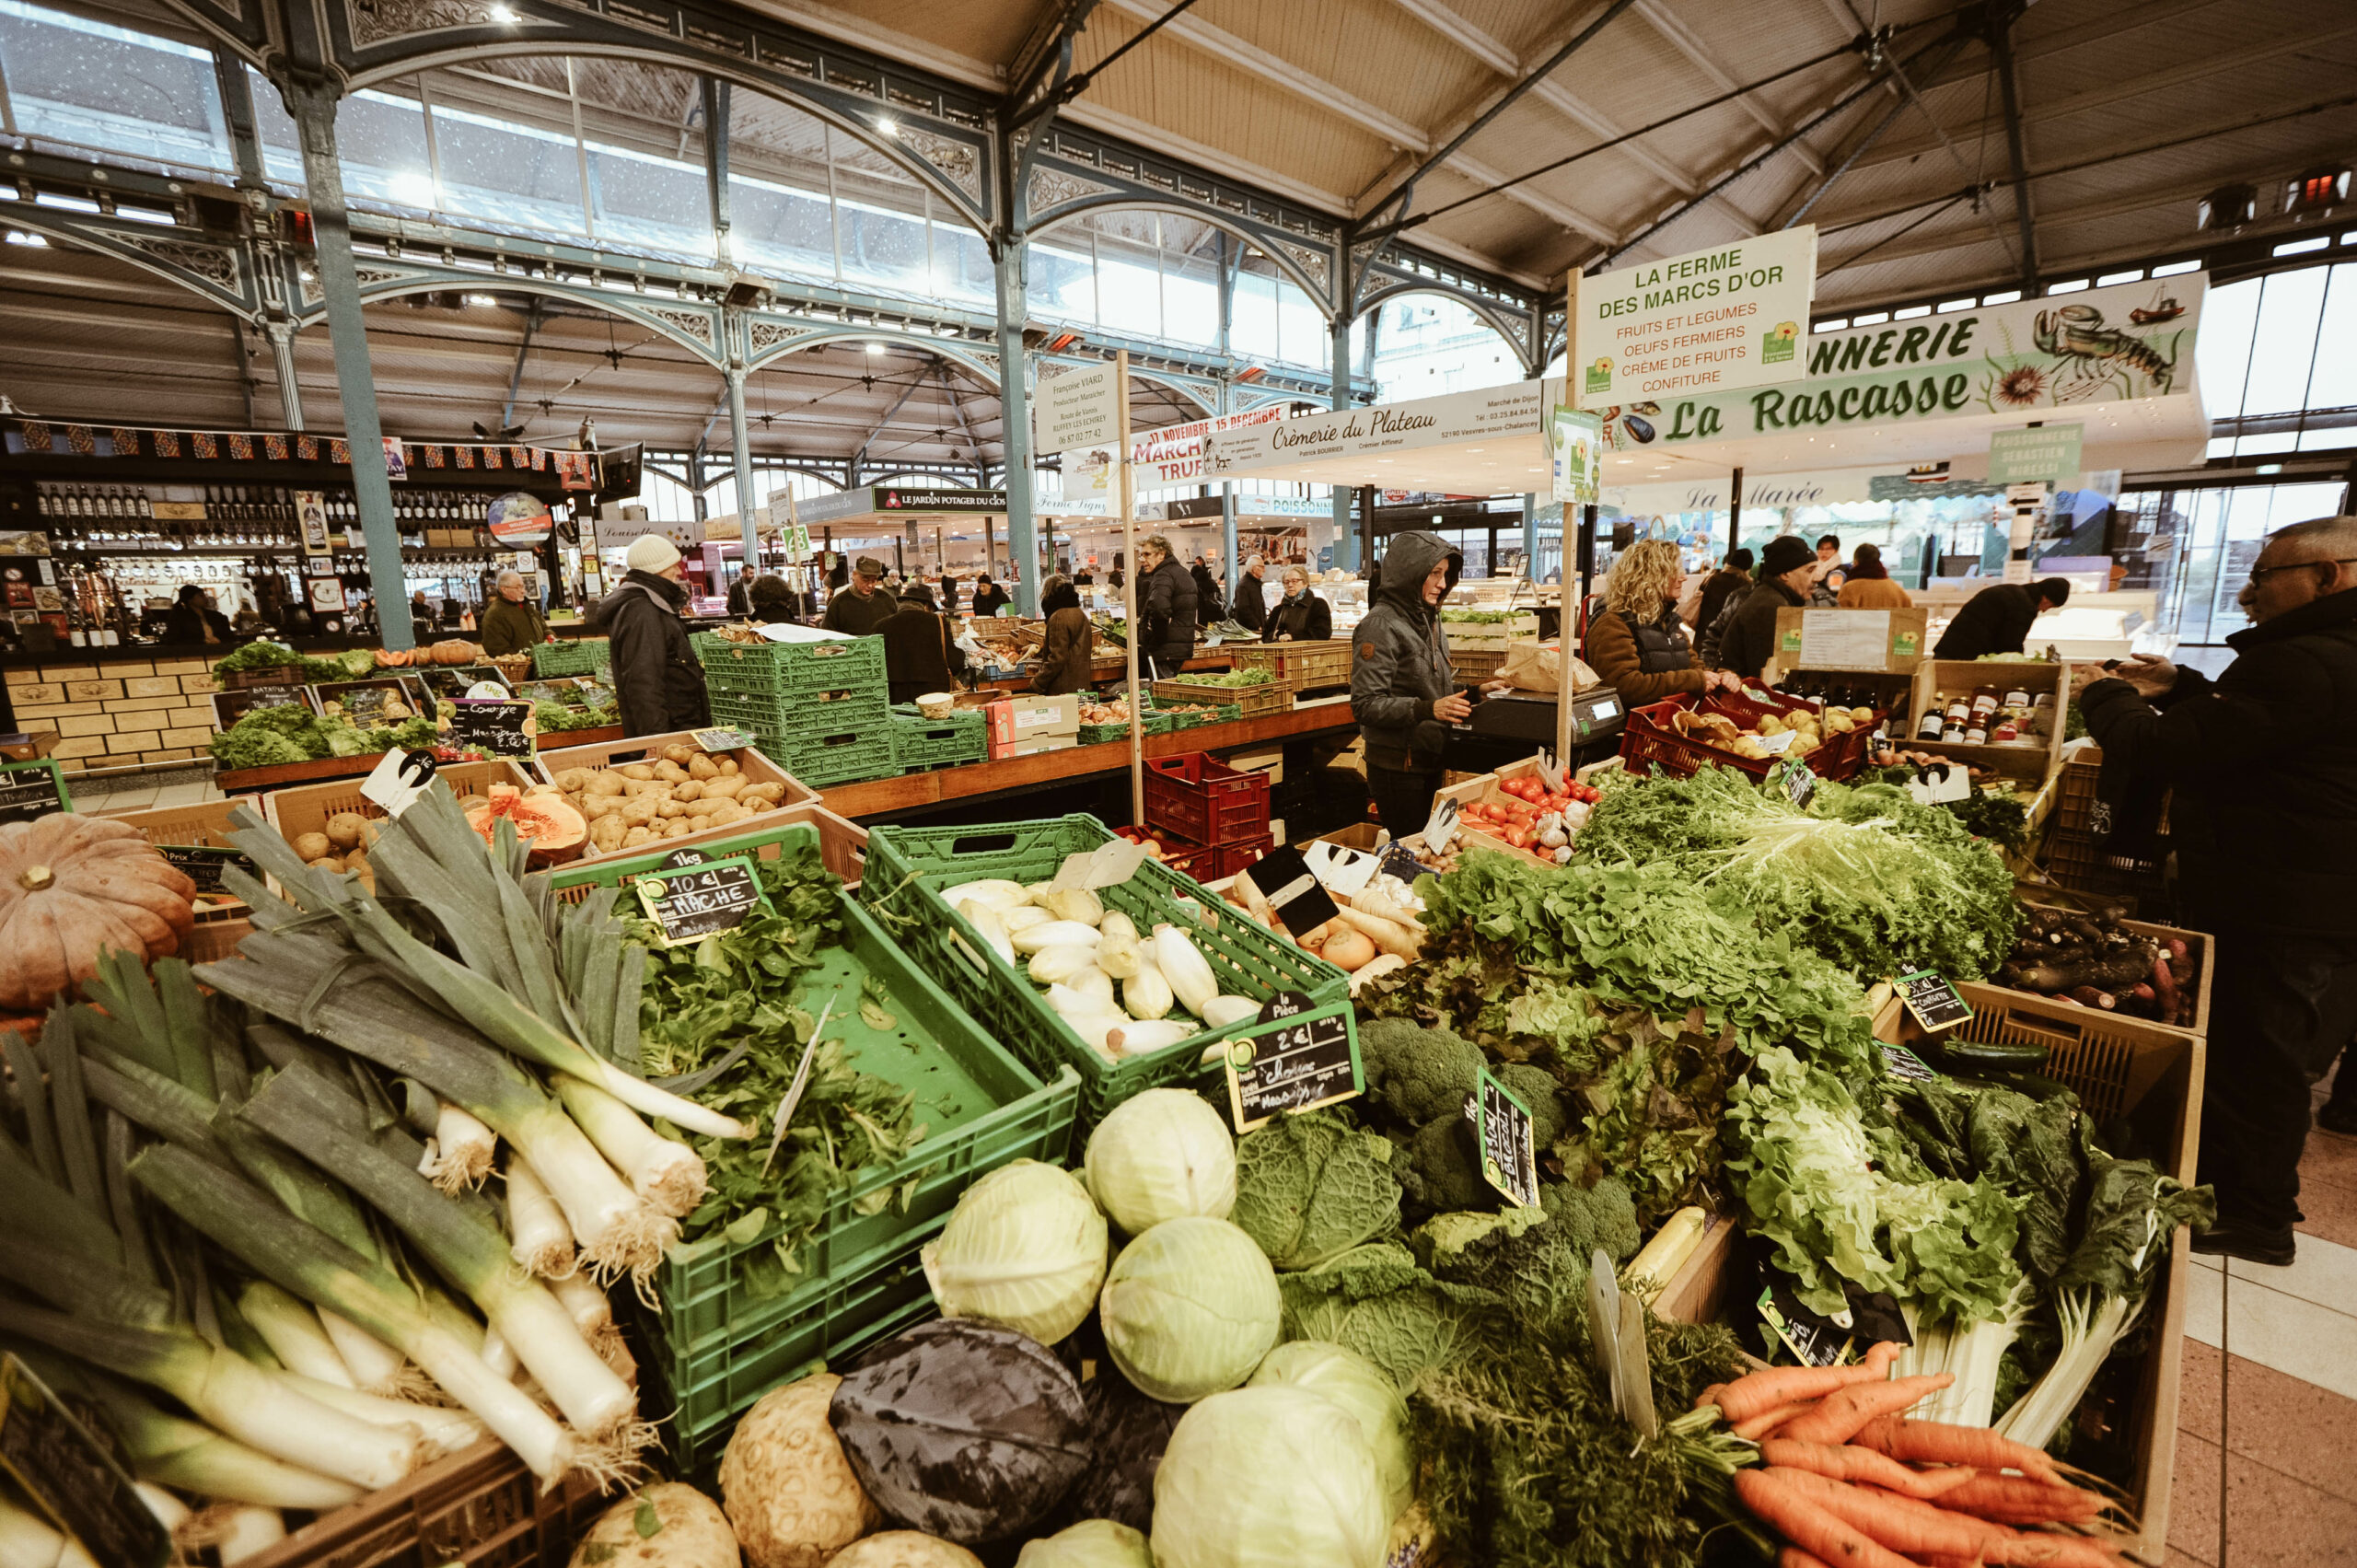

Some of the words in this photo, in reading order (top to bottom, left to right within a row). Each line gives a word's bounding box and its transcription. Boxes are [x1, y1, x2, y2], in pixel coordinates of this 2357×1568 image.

[1635, 268, 1660, 288] LA
[1667, 249, 1742, 281] FERME
[1599, 297, 1638, 319] DES
[1644, 279, 1720, 309] MARCS
[1728, 266, 1783, 293] D'OR
[1617, 320, 1662, 340] FRUITS
[1666, 317, 1683, 331] ET
[1688, 303, 1758, 327] LEGUMES
[1624, 341, 1669, 357] OEUFS
[1673, 326, 1746, 349] FERMIERS
[1806, 318, 1980, 375] NNERIE
[1622, 359, 1668, 377] CRÈME
[1672, 355, 1690, 368] DE
[1695, 346, 1746, 366] FRUITS
[1053, 381, 1080, 396] Françoise
[1081, 374, 1104, 388] VIARD
[1643, 370, 1721, 392] CONFITURE
[1487, 400, 1512, 408] Marché
[1522, 394, 1539, 405] Dijon
[1665, 401, 1723, 441] La
[1752, 373, 1970, 431] Rascasse
[1489, 407, 1538, 421] 03.25.84.84.56
[1058, 436, 1066, 445] 06
[1075, 432, 1084, 441] 02
[1085, 430, 1093, 439] 77
[1093, 428, 1101, 437] 42
[1163, 423, 1210, 443] NOVEMBRE
[1215, 420, 1226, 432] 15
[1272, 424, 1338, 450] Crèmerie
[1342, 414, 1364, 438] du
[1370, 408, 1436, 436] Plateau
[1441, 429, 1460, 438] 52190
[1461, 420, 1538, 436] Vesvres-sous-Chalancey
[1299, 449, 1317, 458] Patrick
[1317, 446, 1344, 456] BOURRIER
[1358, 441, 1381, 449] Crémier
[1381, 438, 1404, 447] Affineur
[901, 495, 912, 504] LE
[912, 491, 941, 505] JARDIN
[941, 497, 976, 505] POTAGER
[976, 497, 988, 505] DU
[989, 494, 1006, 506] CLOS
[1686, 486, 1718, 508] La
[470, 703, 517, 720] Courge
[169, 853, 188, 862] Prix
[672, 851, 703, 867] 1kg
[669, 877, 695, 894] 10
[700, 873, 716, 887] €
[1272, 1004, 1299, 1019] Pièce
[1277, 1032, 1291, 1051] 2
[1293, 1027, 1309, 1045] €
